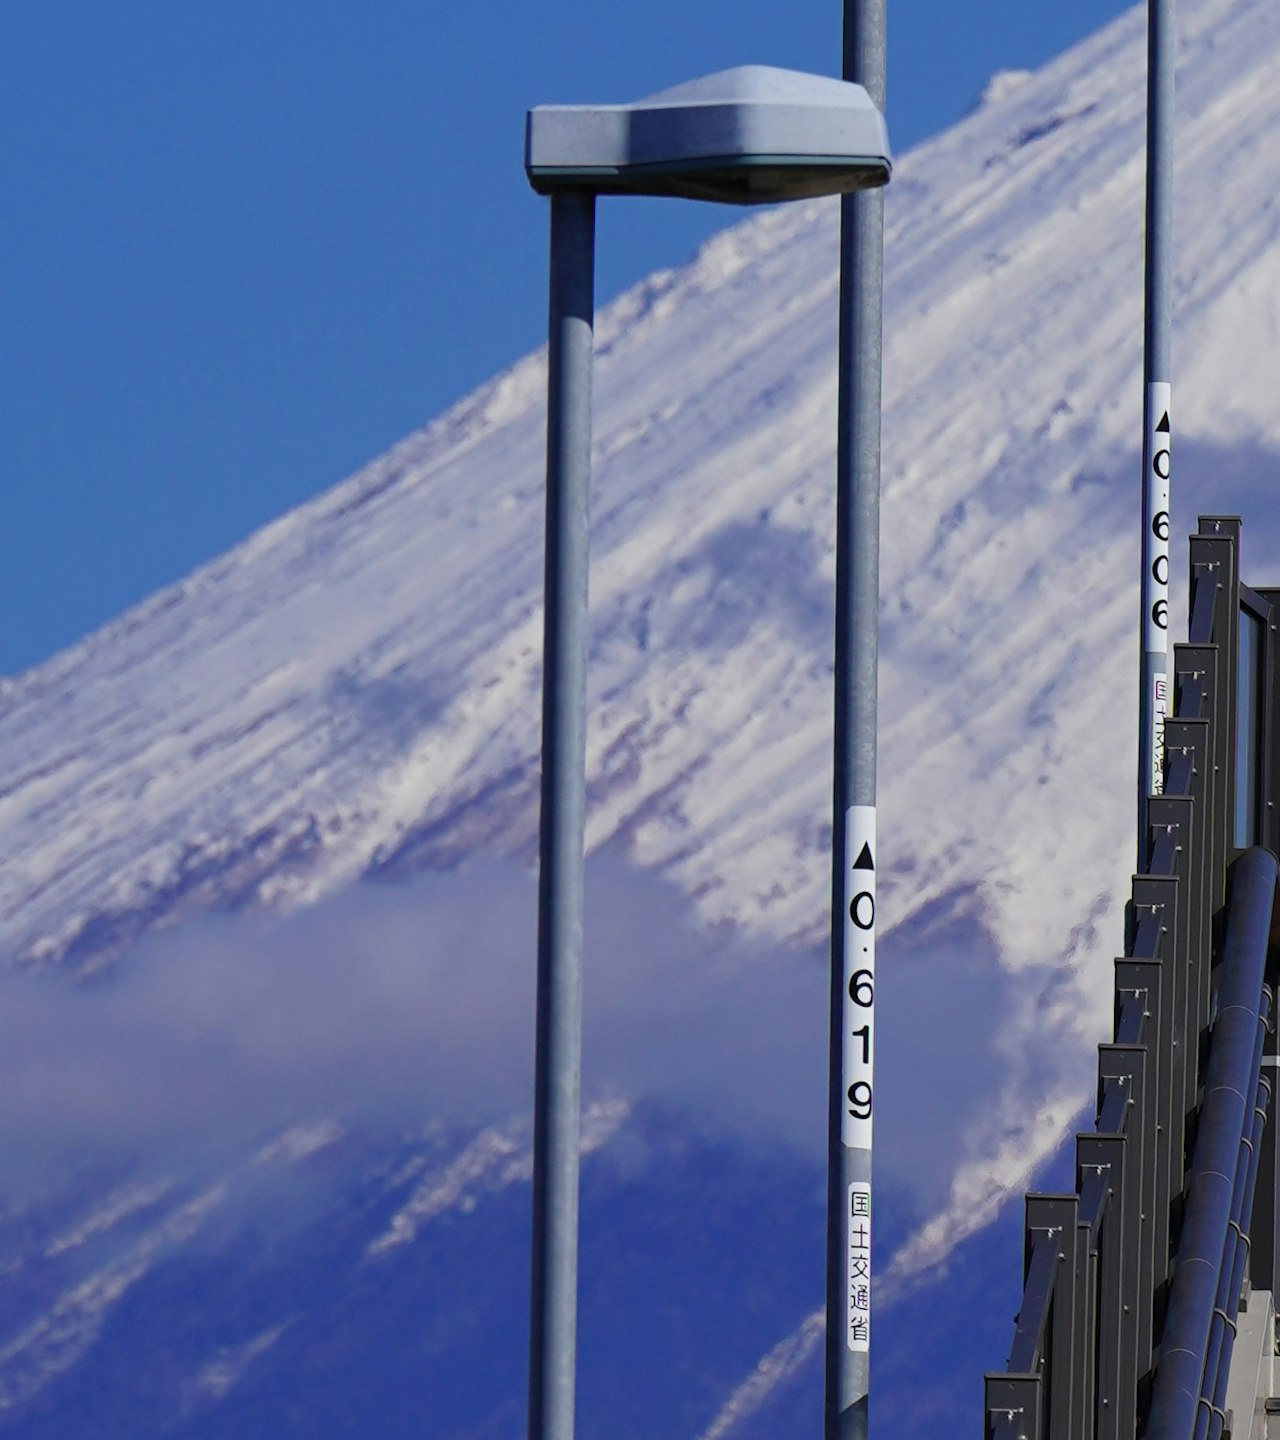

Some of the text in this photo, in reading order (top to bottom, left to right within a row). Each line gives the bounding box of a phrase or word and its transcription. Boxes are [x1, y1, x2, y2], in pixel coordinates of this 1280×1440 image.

[1153, 449, 1170, 630] 0.606
[848, 891, 875, 1120] 0.619
[850, 1191, 870, 1341] 国土交通省
